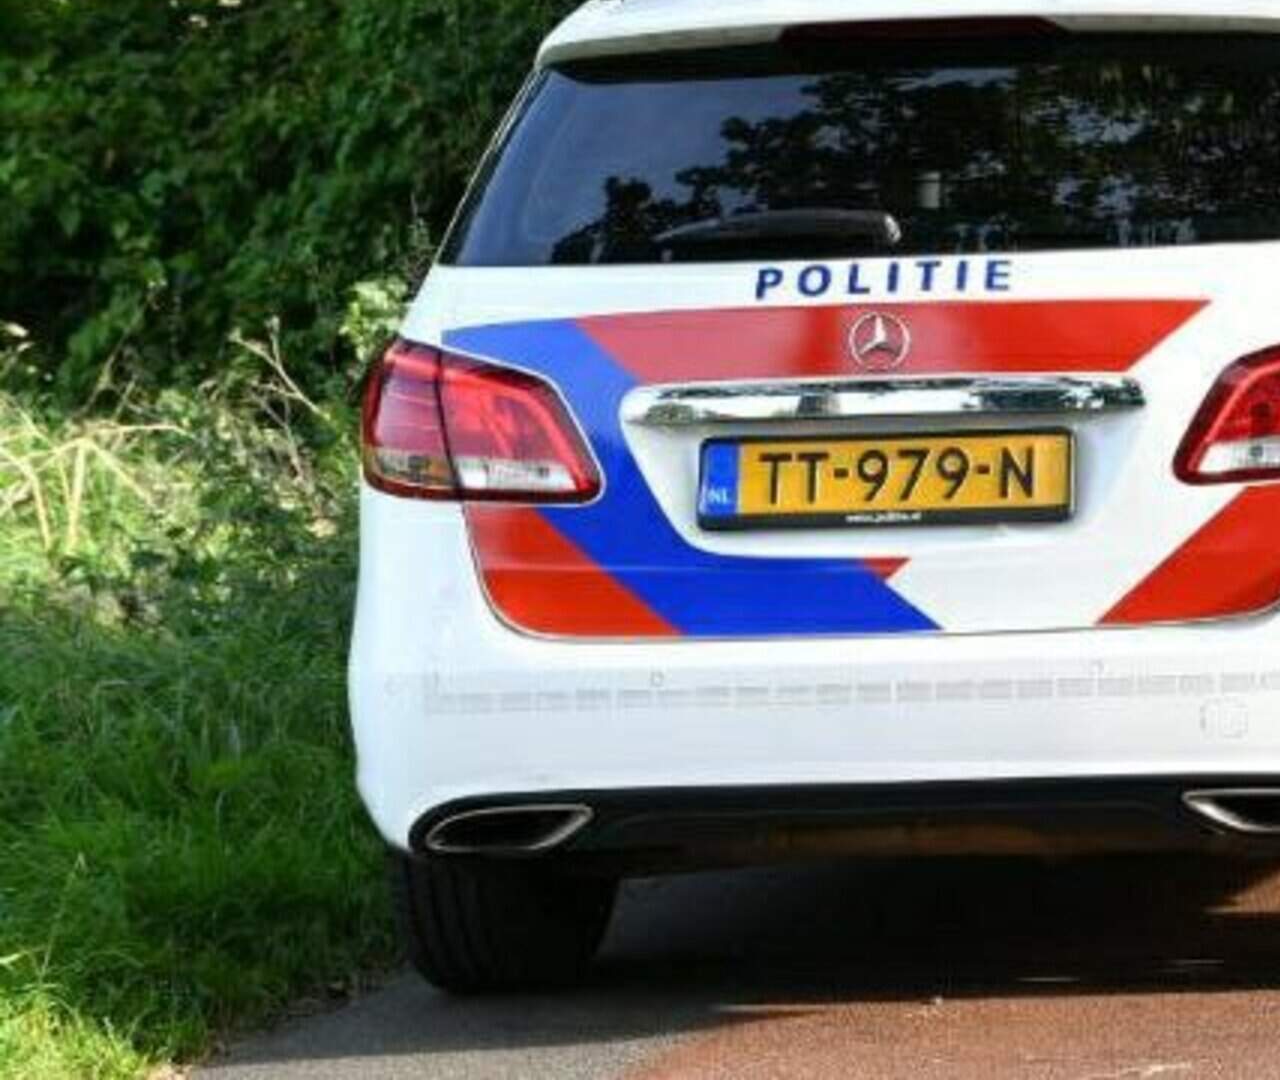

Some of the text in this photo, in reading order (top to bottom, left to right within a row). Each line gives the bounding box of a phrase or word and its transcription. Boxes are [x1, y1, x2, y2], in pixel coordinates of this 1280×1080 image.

[755, 260, 1012, 300] POLITIE
[758, 446, 1036, 505] TT-979-N
[708, 489, 730, 505] NL
